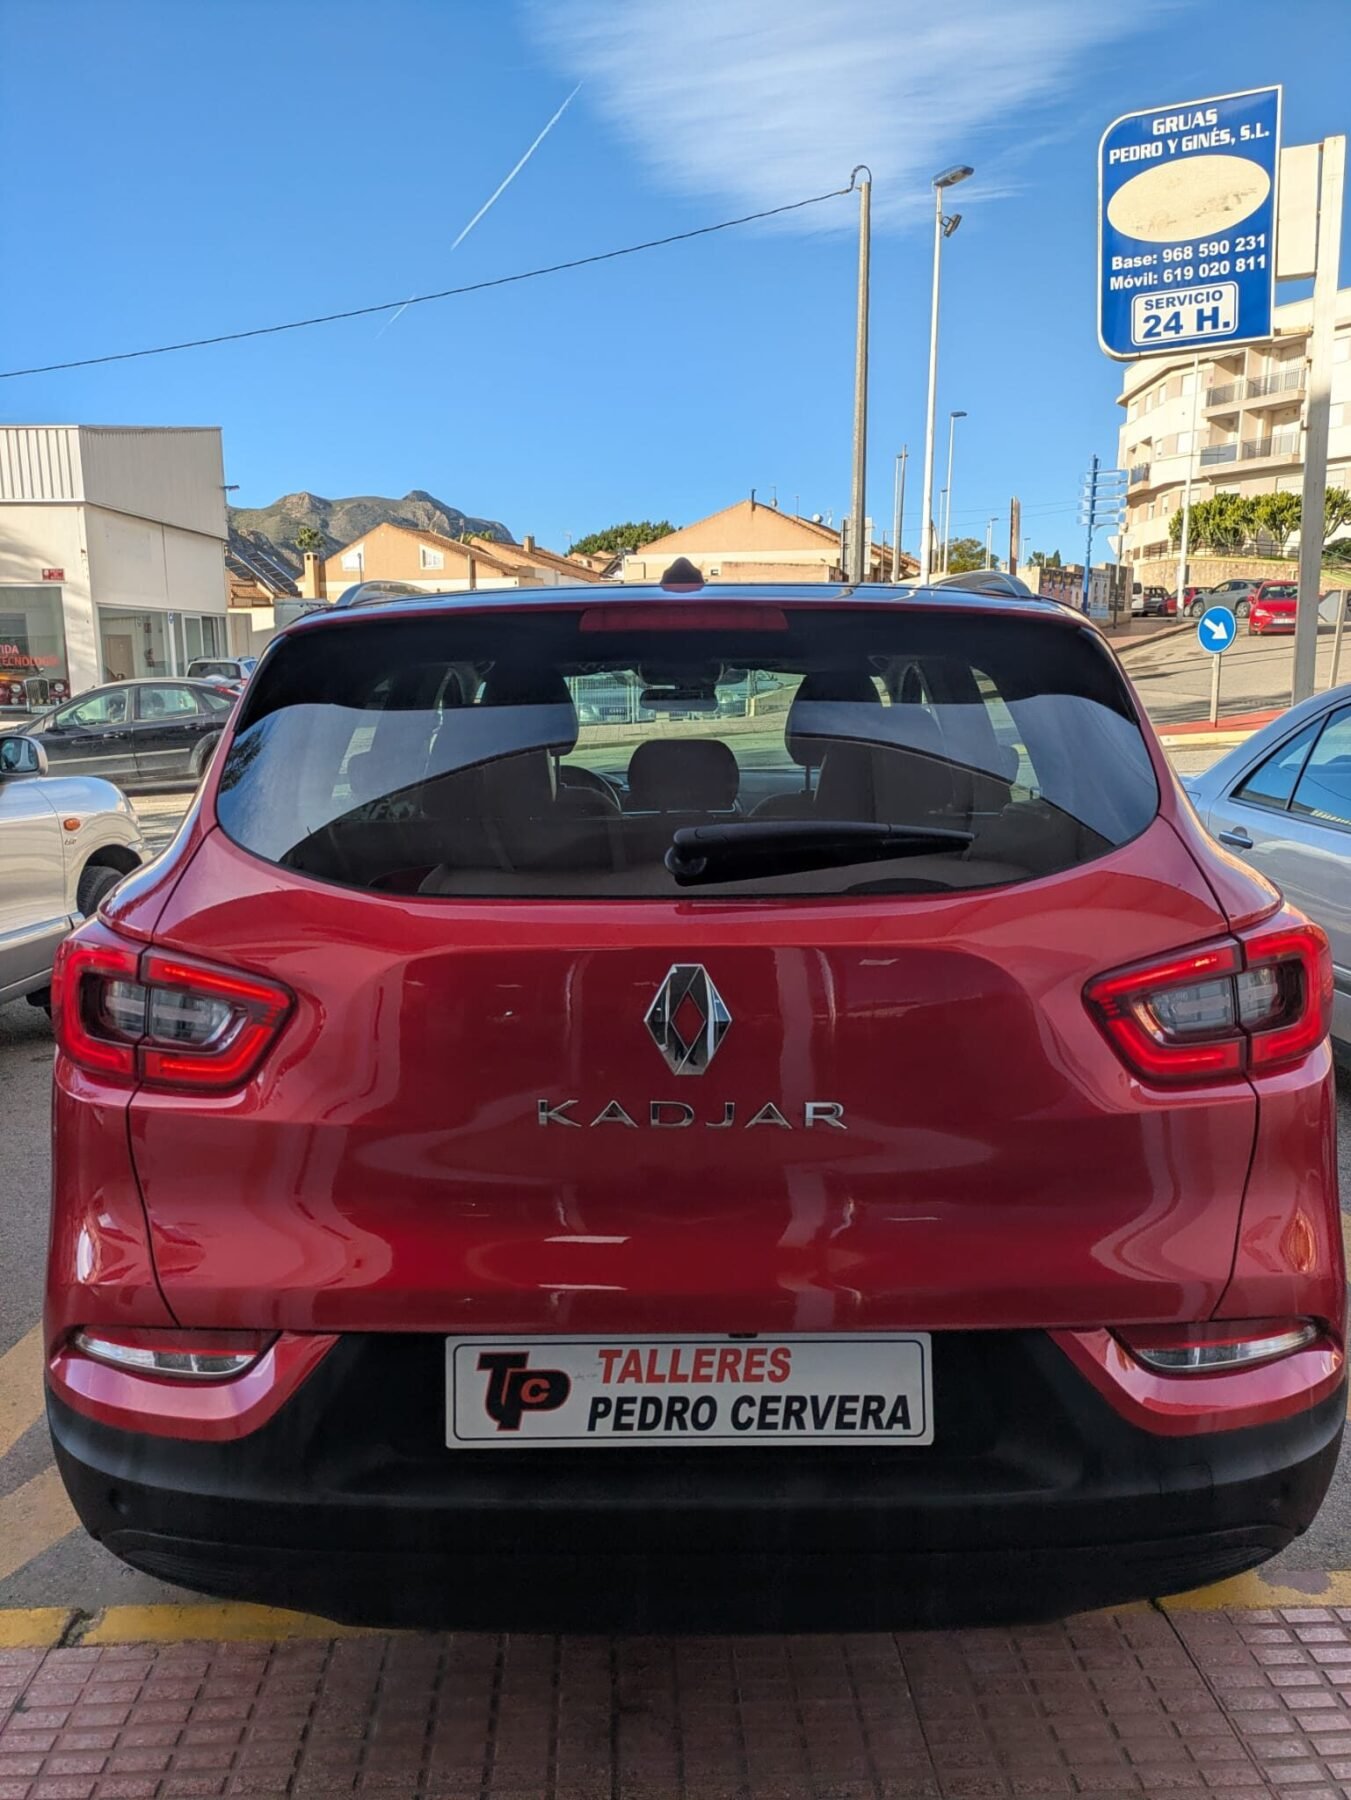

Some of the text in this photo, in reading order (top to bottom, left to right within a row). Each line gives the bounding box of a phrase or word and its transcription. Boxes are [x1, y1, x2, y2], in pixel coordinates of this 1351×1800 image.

[1152, 108, 1218, 136] GRUAS
[1109, 122, 1270, 165] PEDRO Y GINÉS, S.L.
[1111, 233, 1265, 270] Base: 968 590 231
[1110, 255, 1266, 290] Móvil: 619 020 811
[1144, 289, 1223, 311] SERVICIO
[1142, 306, 1231, 339] 24 H.
[537, 1099, 847, 1129] KADJAR
[598, 1347, 792, 1384] TALLERES
[587, 1394, 912, 1432] PEDRO CERVERA
